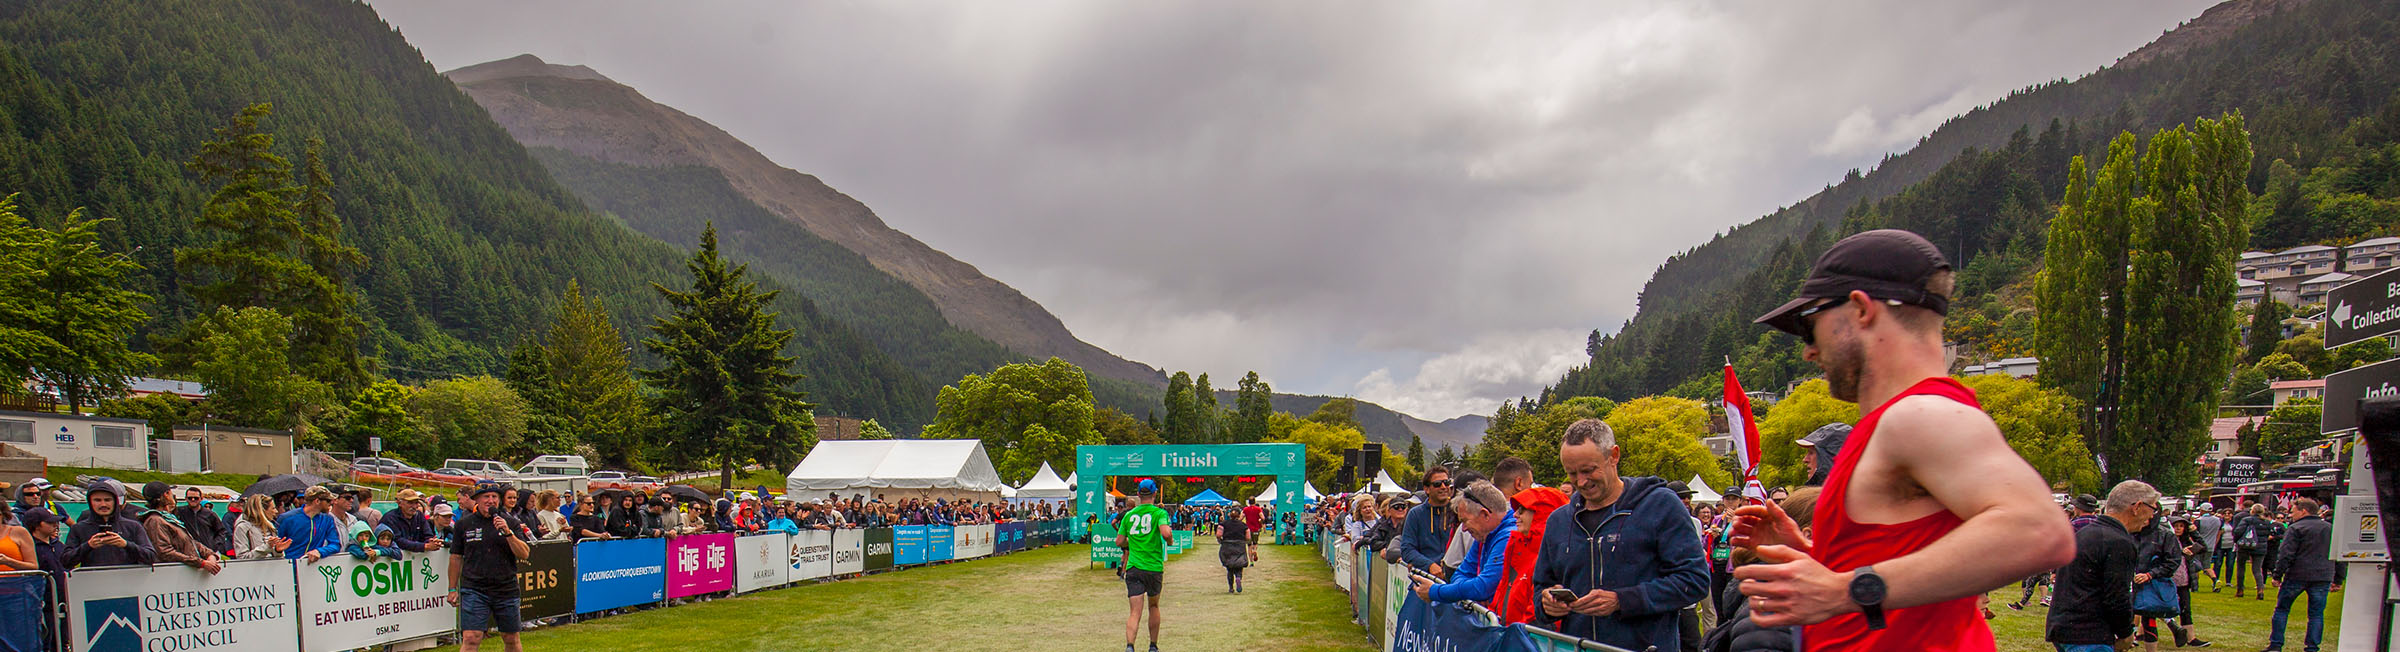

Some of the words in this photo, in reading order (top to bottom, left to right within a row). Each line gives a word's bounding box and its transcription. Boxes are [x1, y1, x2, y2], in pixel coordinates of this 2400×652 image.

[55, 433, 75, 442] HEB
[1161, 451, 1218, 468] Finish
[1129, 513, 1152, 535] 29
[800, 545, 830, 554] QUEENSTOWN
[835, 550, 860, 564] GARMIN
[867, 542, 892, 556] GARMIN
[800, 555, 815, 564] TRAILS
[815, 553, 829, 561] TRUST
[351, 560, 413, 597] OSM
[582, 565, 662, 582] #LOOKINGOUTFORQUEENSTOWN
[753, 568, 775, 580] AKARUA
[144, 584, 275, 614] QUEENSTOWN
[147, 611, 201, 633] LAKES
[207, 603, 286, 626] DISTRICT
[315, 611, 339, 626] EAT
[342, 606, 377, 622] WELL,
[378, 603, 391, 617] BE
[393, 595, 445, 614] BRILLIANT
[376, 624, 400, 636] OSM.NZ
[148, 628, 237, 652] COUNCIL
